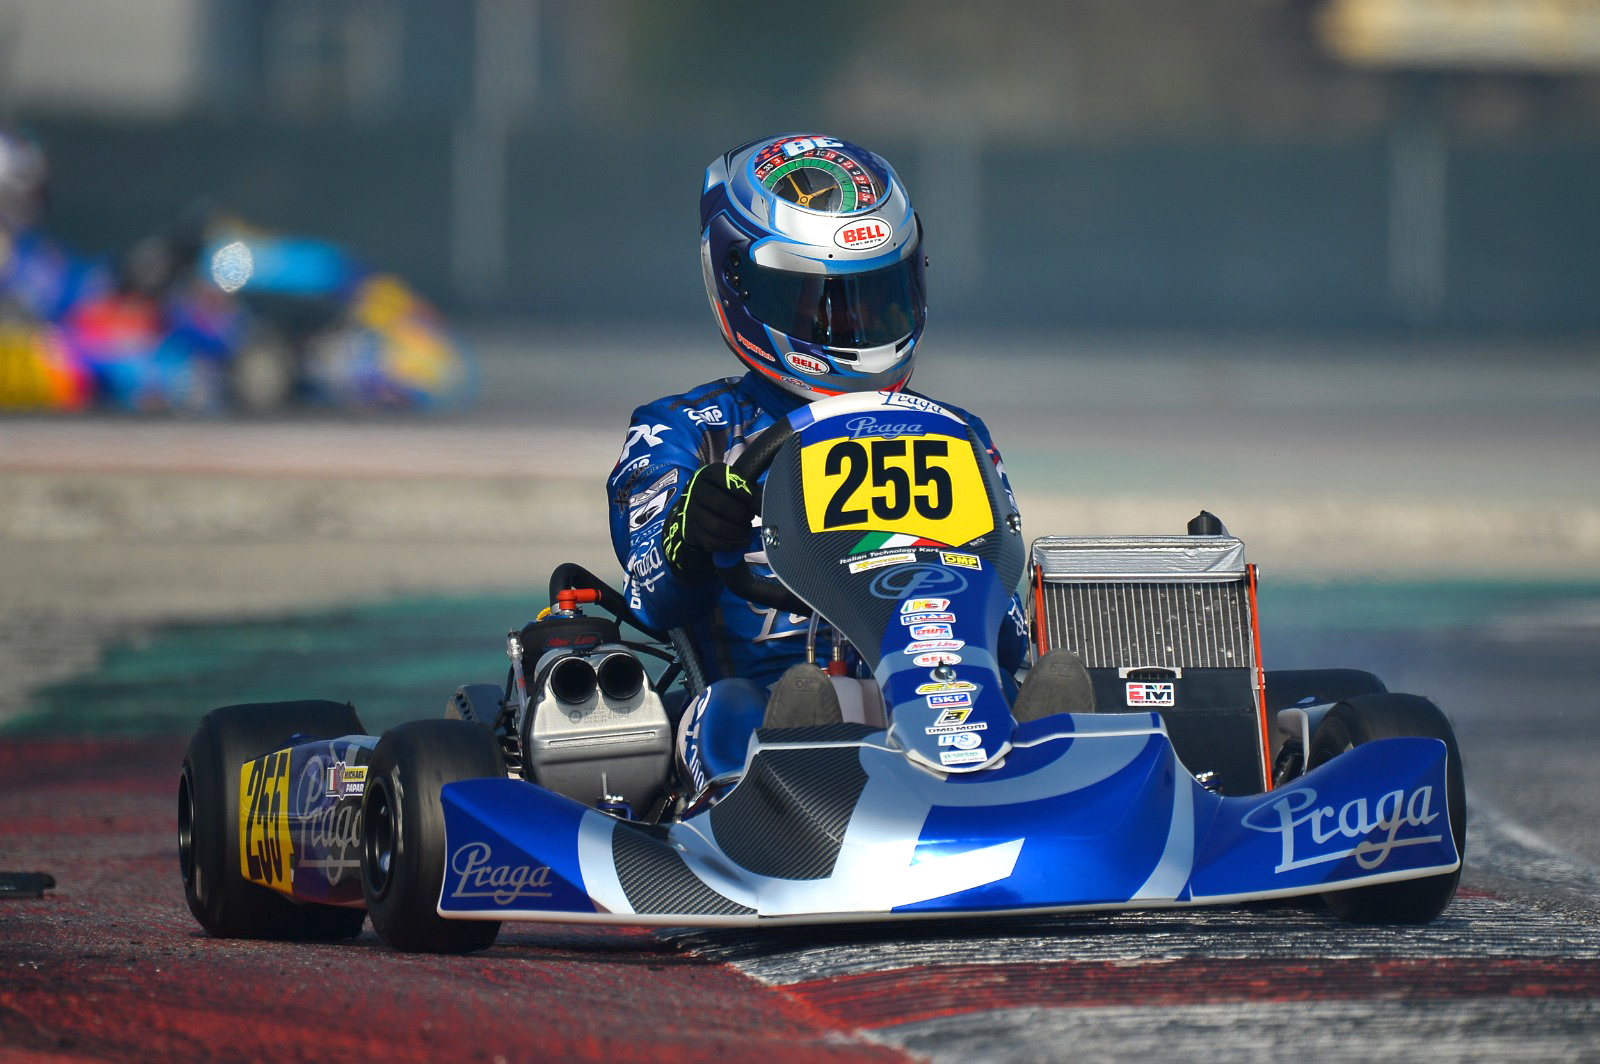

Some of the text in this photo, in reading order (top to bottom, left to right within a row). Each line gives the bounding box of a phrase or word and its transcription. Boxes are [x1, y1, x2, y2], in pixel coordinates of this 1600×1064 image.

[842, 225, 885, 243] BELL
[792, 356, 822, 371] BELL
[846, 416, 924, 439] Praga
[823, 440, 953, 530] 255
[840, 555, 867, 564] Italian
[869, 548, 917, 558] Technology
[944, 555, 977, 567] OMP
[932, 694, 966, 703] SKF
[942, 735, 969, 744] ITS
[344, 770, 364, 779] MICHAEL
[246, 752, 289, 885] 255
[1241, 786, 1443, 874] Praga
[451, 842, 552, 906] Praga
